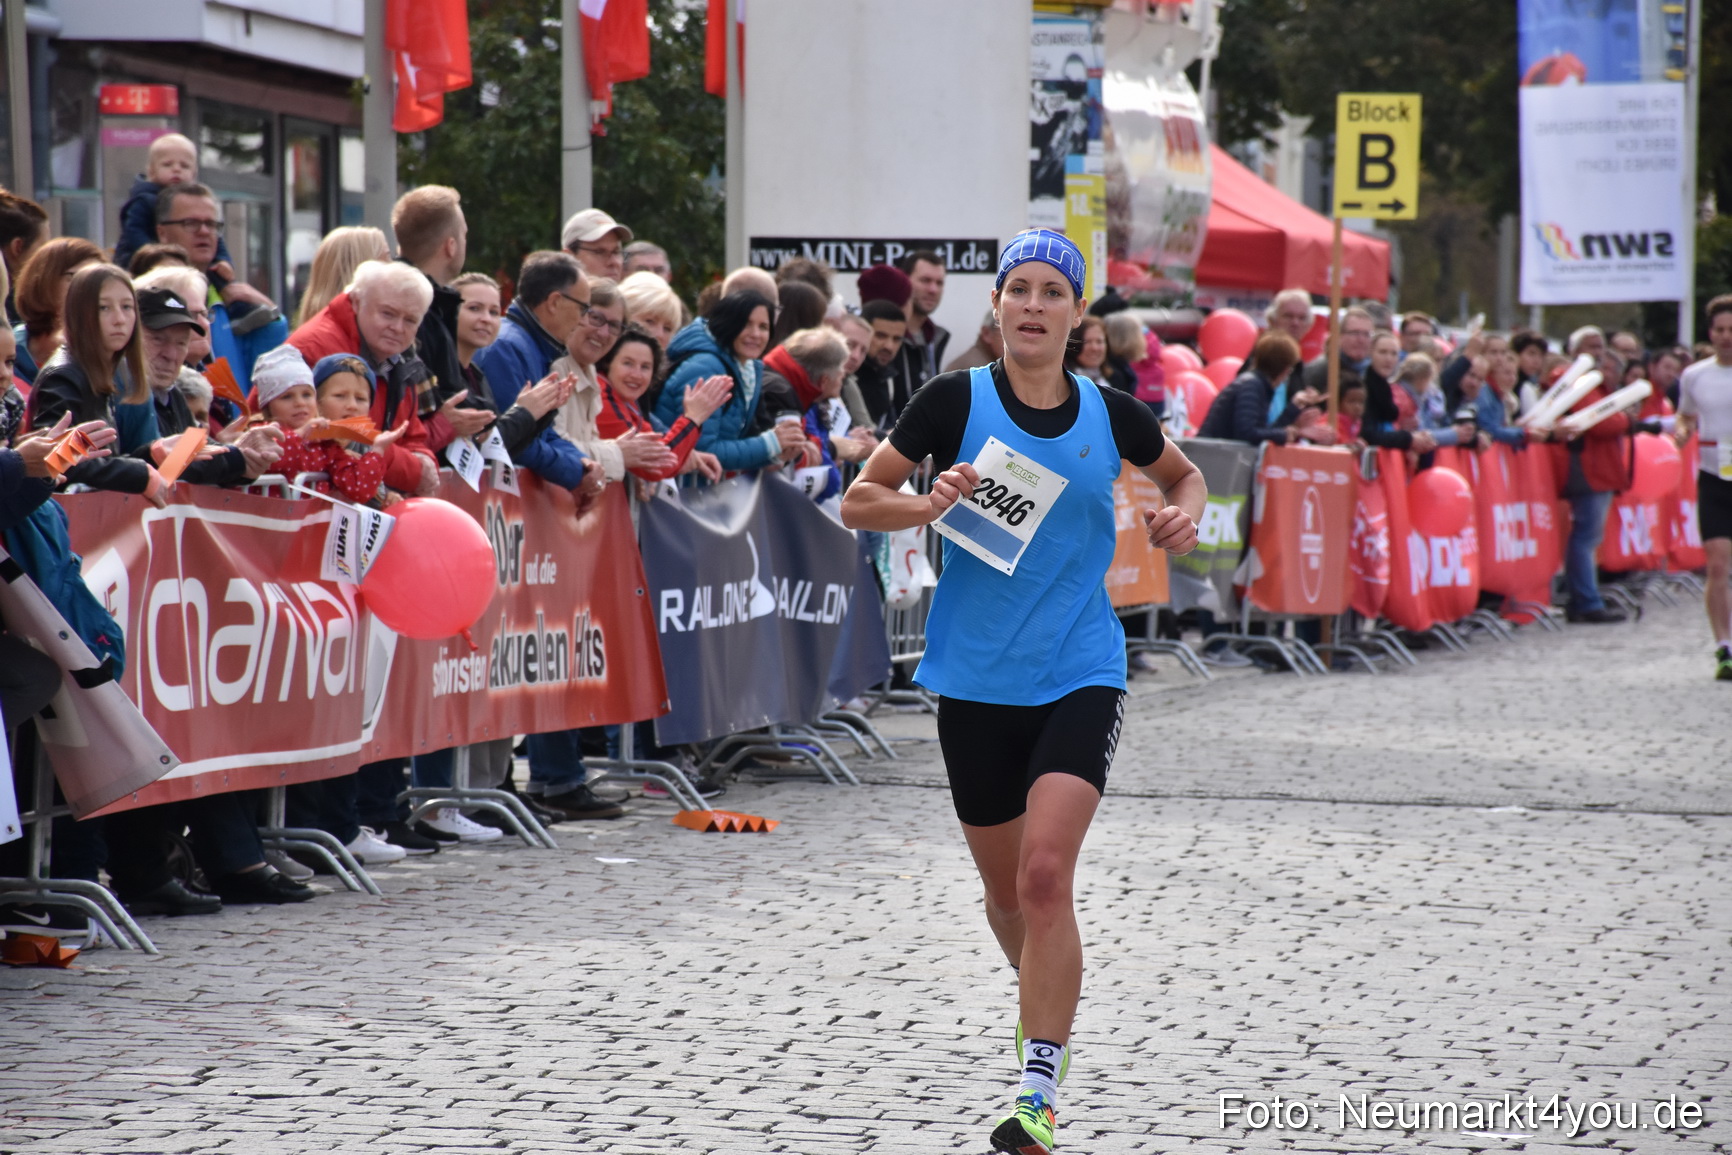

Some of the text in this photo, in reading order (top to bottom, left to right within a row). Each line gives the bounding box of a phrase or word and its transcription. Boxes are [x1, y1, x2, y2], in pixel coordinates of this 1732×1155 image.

[1348, 101, 1410, 122] Block
[1358, 133, 1396, 190] B
[1012, 464, 1041, 486] BOCK
[968, 477, 1036, 527] 2946
[336, 515, 349, 558] swn
[365, 511, 382, 552] swn
